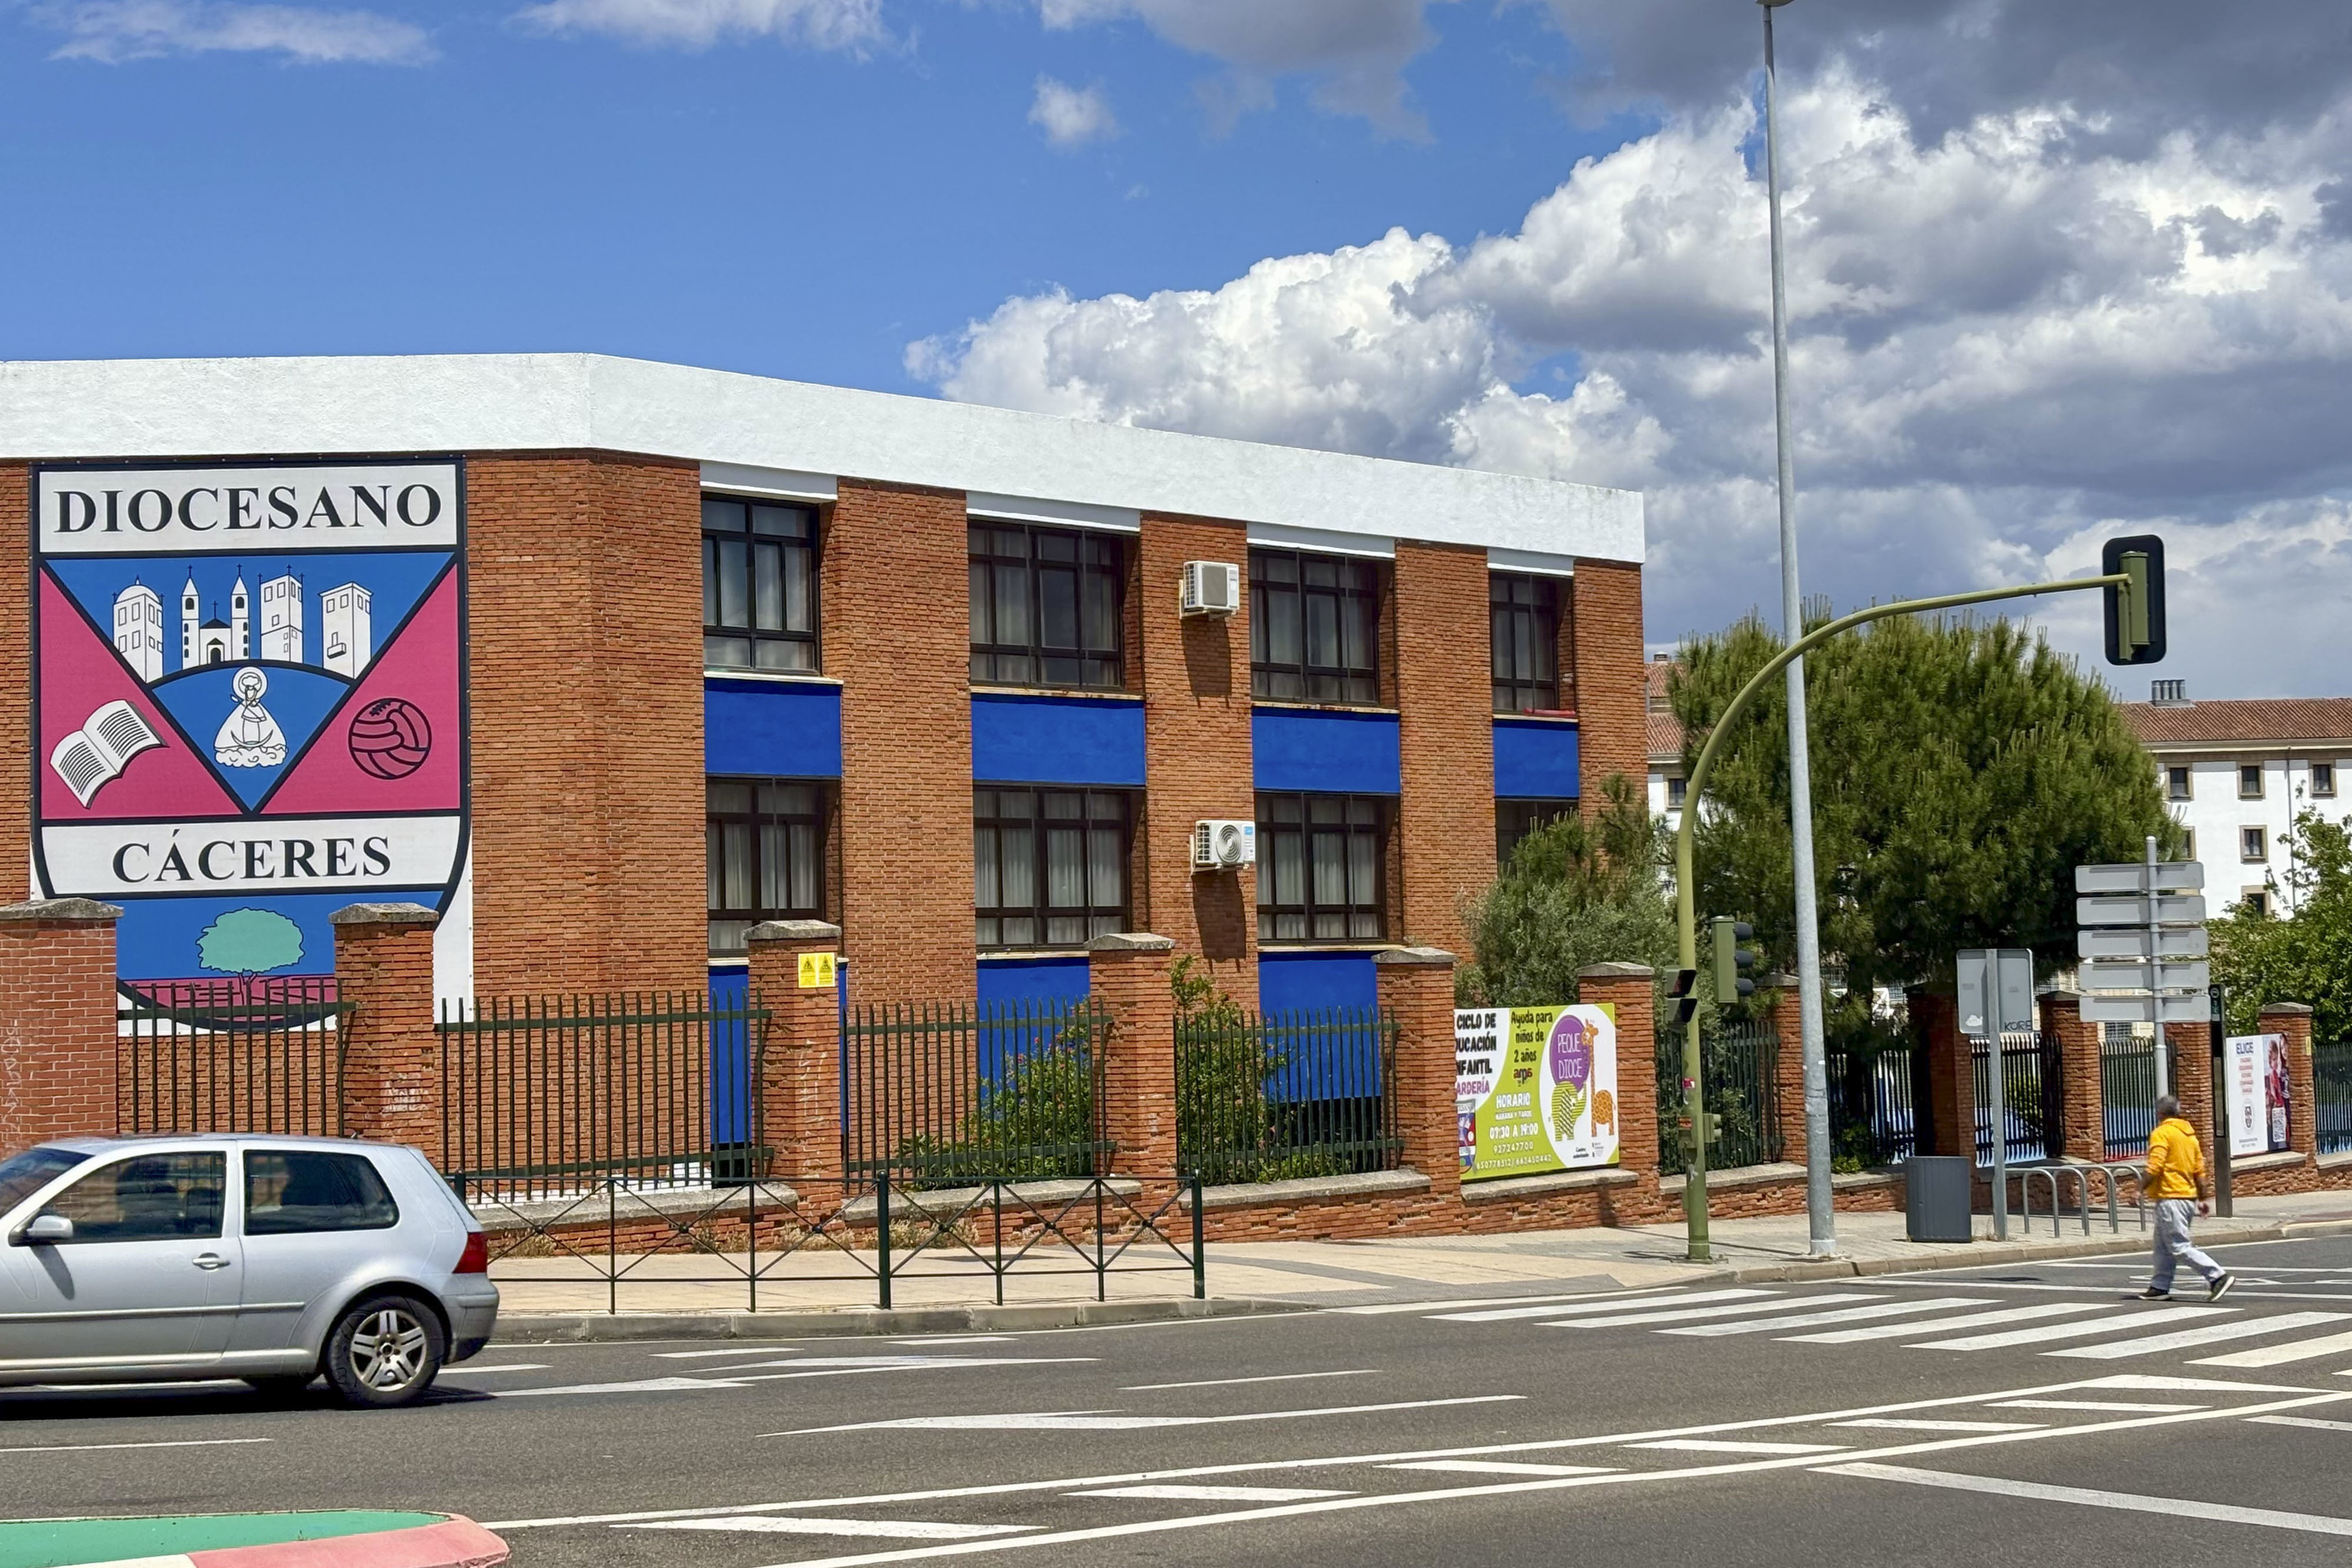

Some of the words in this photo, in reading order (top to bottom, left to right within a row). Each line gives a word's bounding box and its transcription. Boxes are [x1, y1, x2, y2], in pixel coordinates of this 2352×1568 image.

[54, 483, 442, 534] DIOCESANO
[112, 828, 391, 883] CÁCERES
[1456, 1013, 1482, 1030] CICLO
[1485, 1013, 1497, 1029] DE
[1511, 1010, 1534, 1028] Ayuda
[1536, 1011, 1553, 1027] para
[1455, 1031, 1497, 1053] UCACIÓN
[1515, 1029, 1534, 1044] niños
[1535, 1027, 1544, 1042] de
[1557, 1032, 1581, 1054] PEQUE
[1514, 1049, 1519, 1063] 2
[1521, 1048, 1537, 1063] años
[1456, 1058, 1492, 1076] NFANTIL
[1558, 1058, 1583, 1080] DIOCE
[1456, 1076, 1490, 1096] ARDERÍA
[1496, 1092, 1530, 1109] HORARIO
[1489, 1125, 1510, 1139] 07:30
[1512, 1124, 1518, 1138] A
[1520, 1122, 1538, 1136] 19:00
